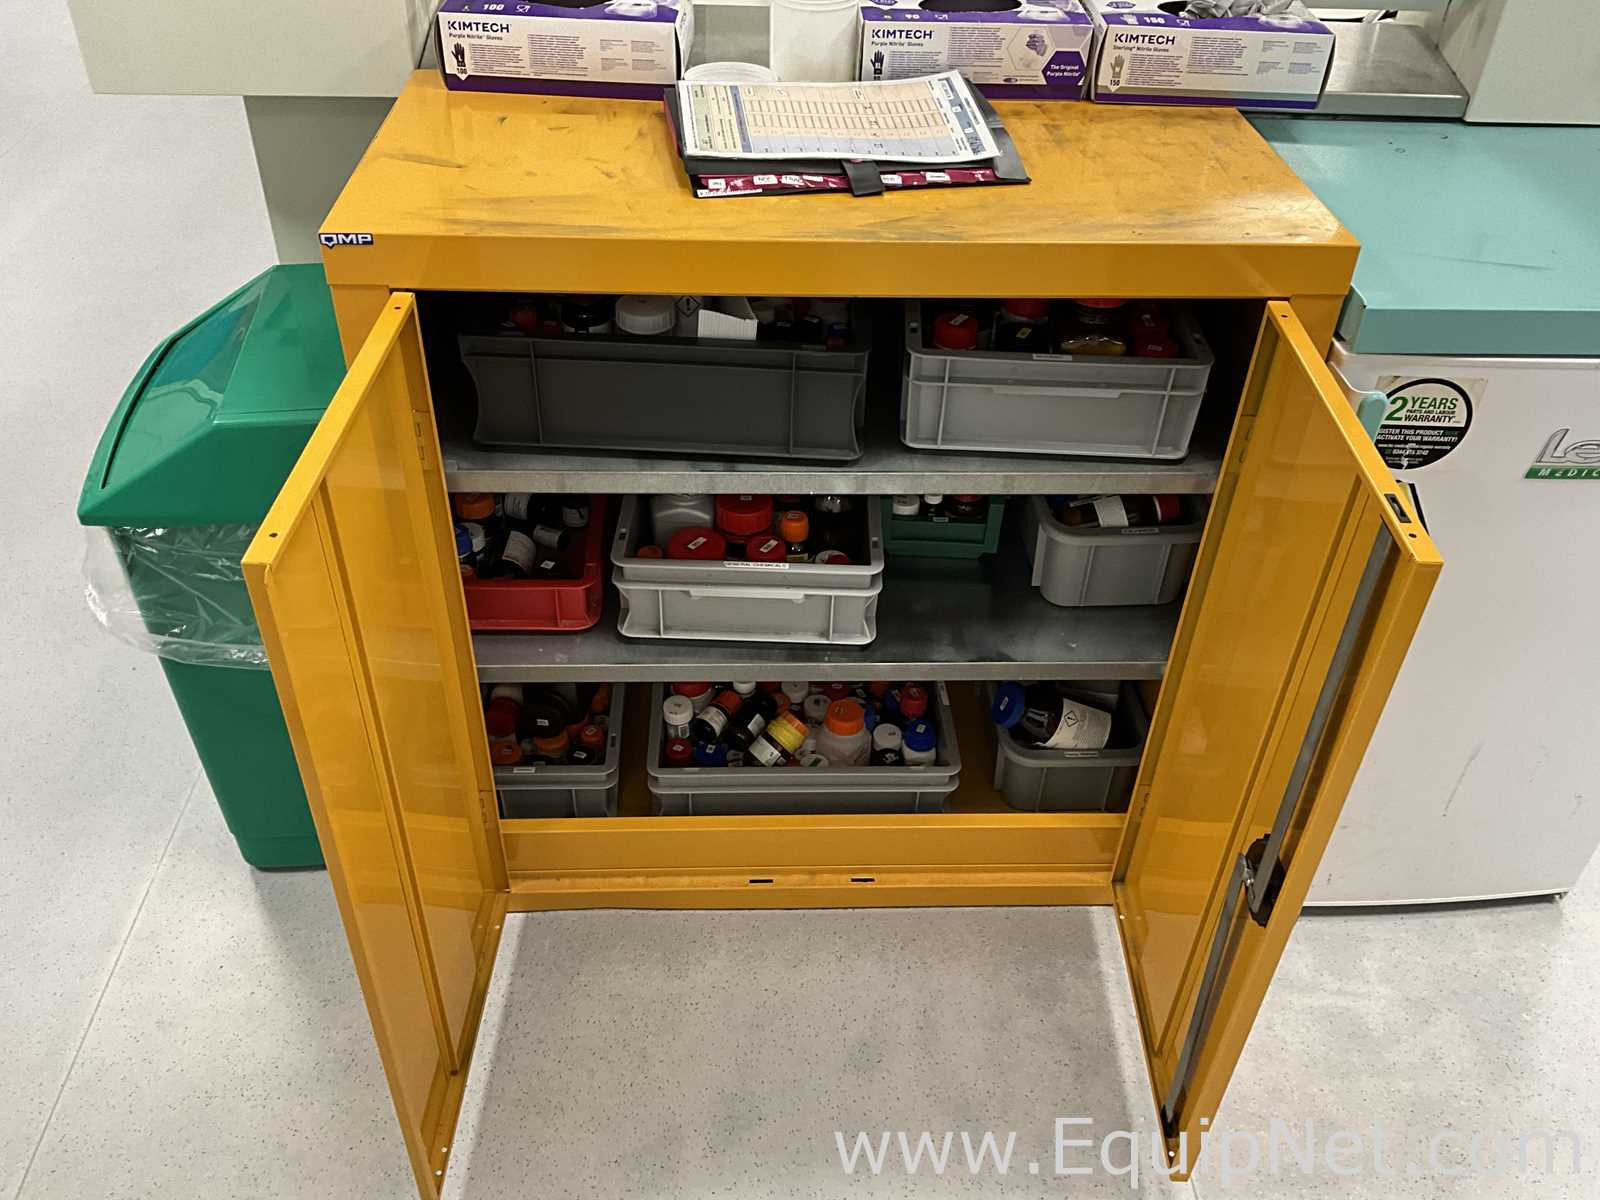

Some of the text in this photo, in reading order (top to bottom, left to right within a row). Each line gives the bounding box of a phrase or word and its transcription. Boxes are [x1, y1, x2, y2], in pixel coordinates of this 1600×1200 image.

[483, 3, 505, 11] 100
[1144, 16, 1165, 24] 150
[448, 20, 510, 33] KIMTECH
[872, 29, 933, 39] KIMTECH
[1114, 33, 1176, 45] KIMTECH
[456, 67, 468, 75] 100
[1109, 79, 1121, 87] 150
[319, 233, 373, 248] QMP
[1384, 396, 1458, 421] 2 YEARS
